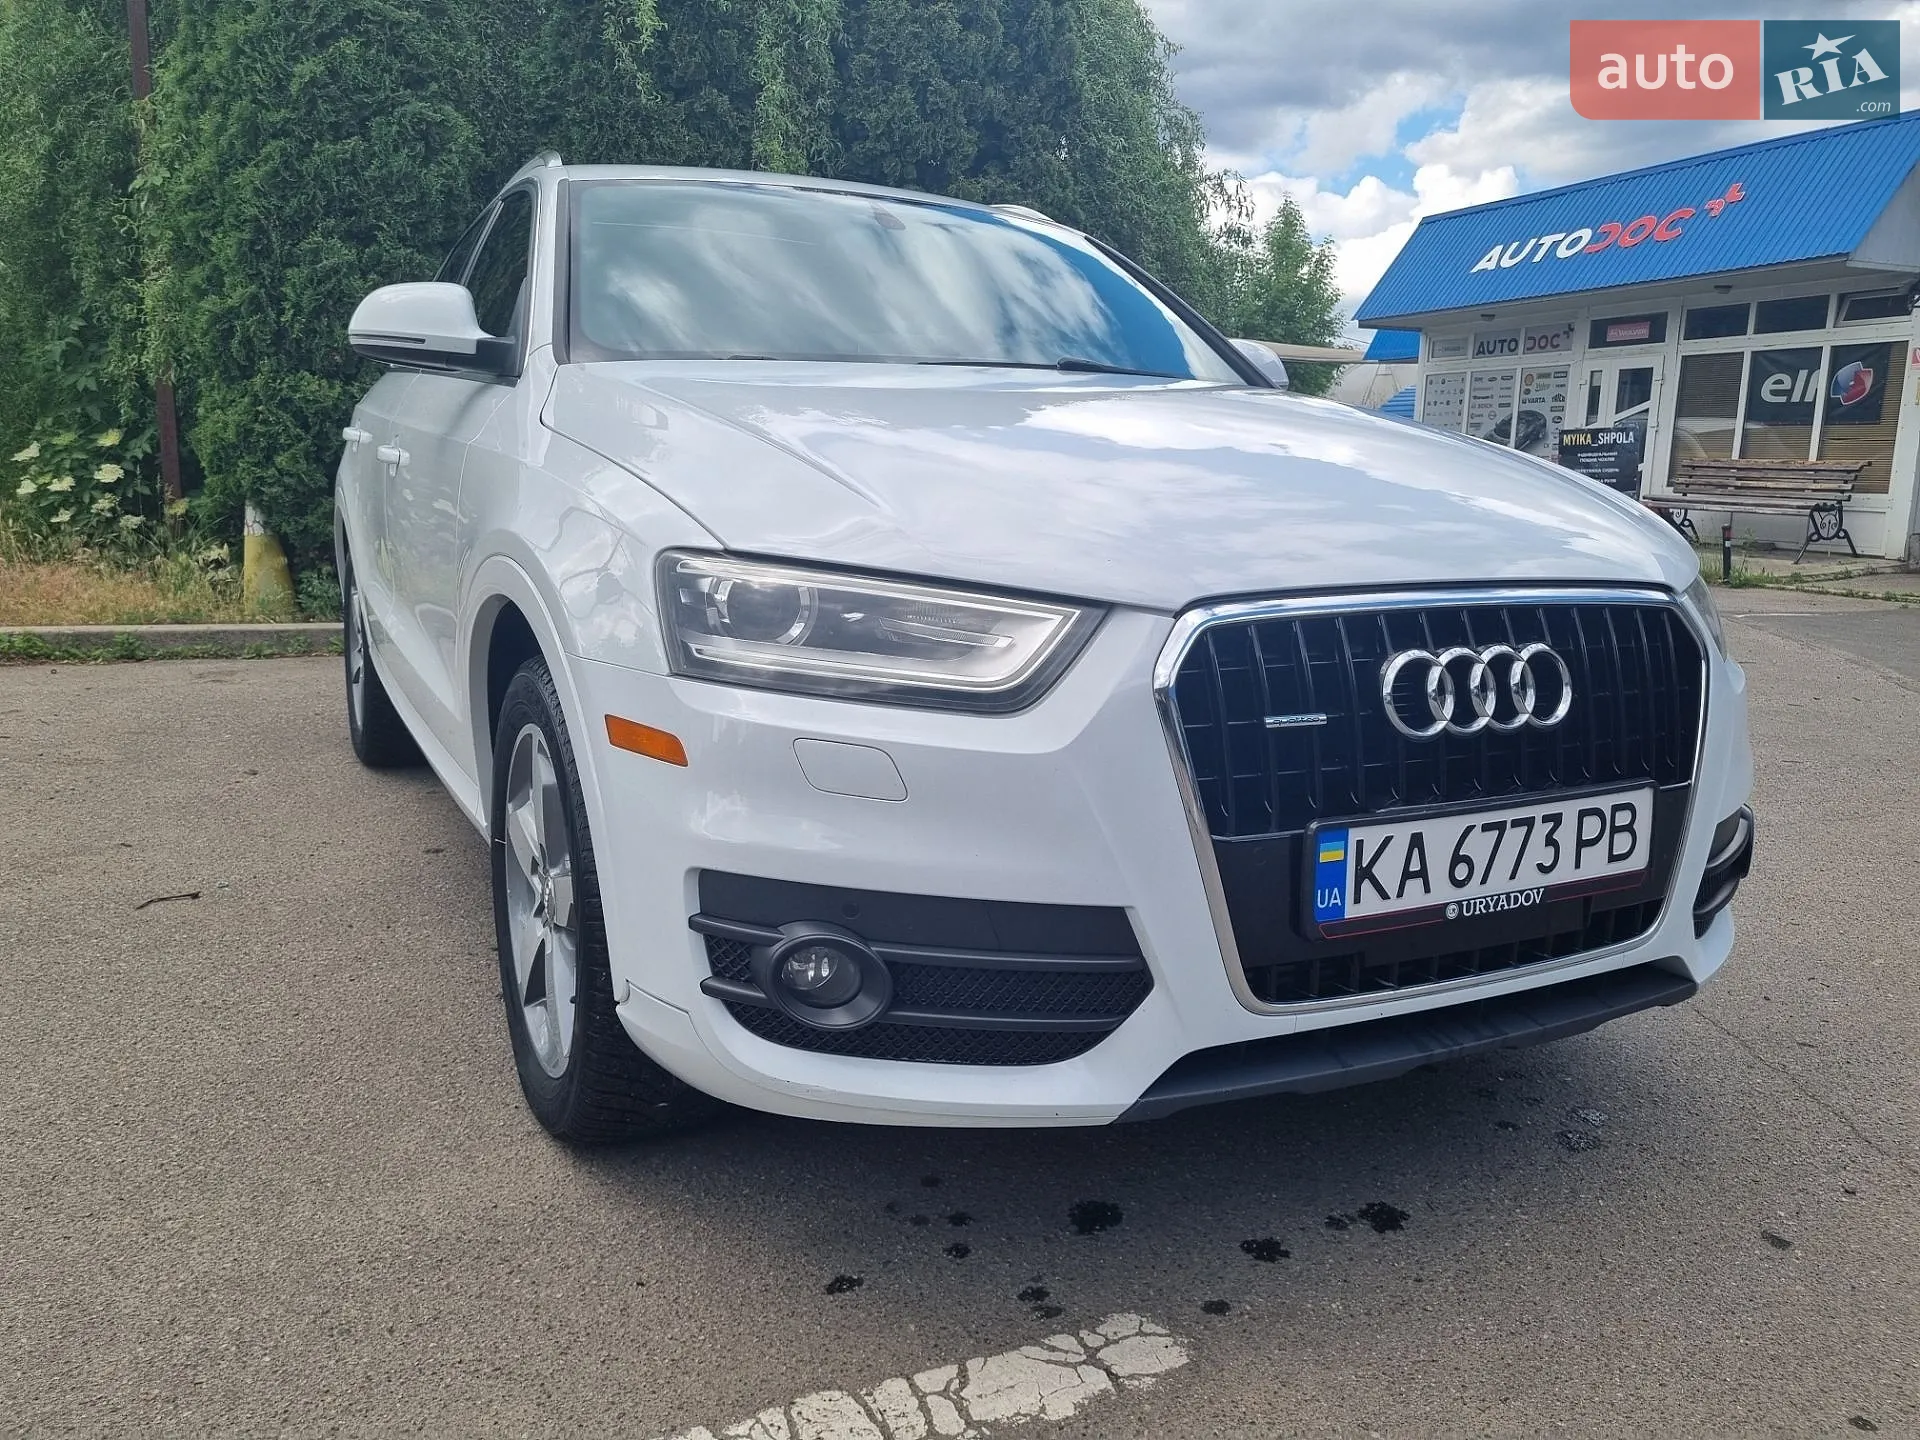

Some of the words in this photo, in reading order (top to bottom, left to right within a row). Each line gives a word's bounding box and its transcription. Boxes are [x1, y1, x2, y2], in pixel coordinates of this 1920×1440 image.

[1476, 337, 1519, 356] AUTO
[1526, 333, 1561, 351] DOC
[1353, 831, 1432, 904] KA
[1449, 812, 1563, 889] 6773
[1574, 802, 1638, 870] PB
[1317, 887, 1342, 908] UA
[1462, 888, 1545, 916] URYADOV
